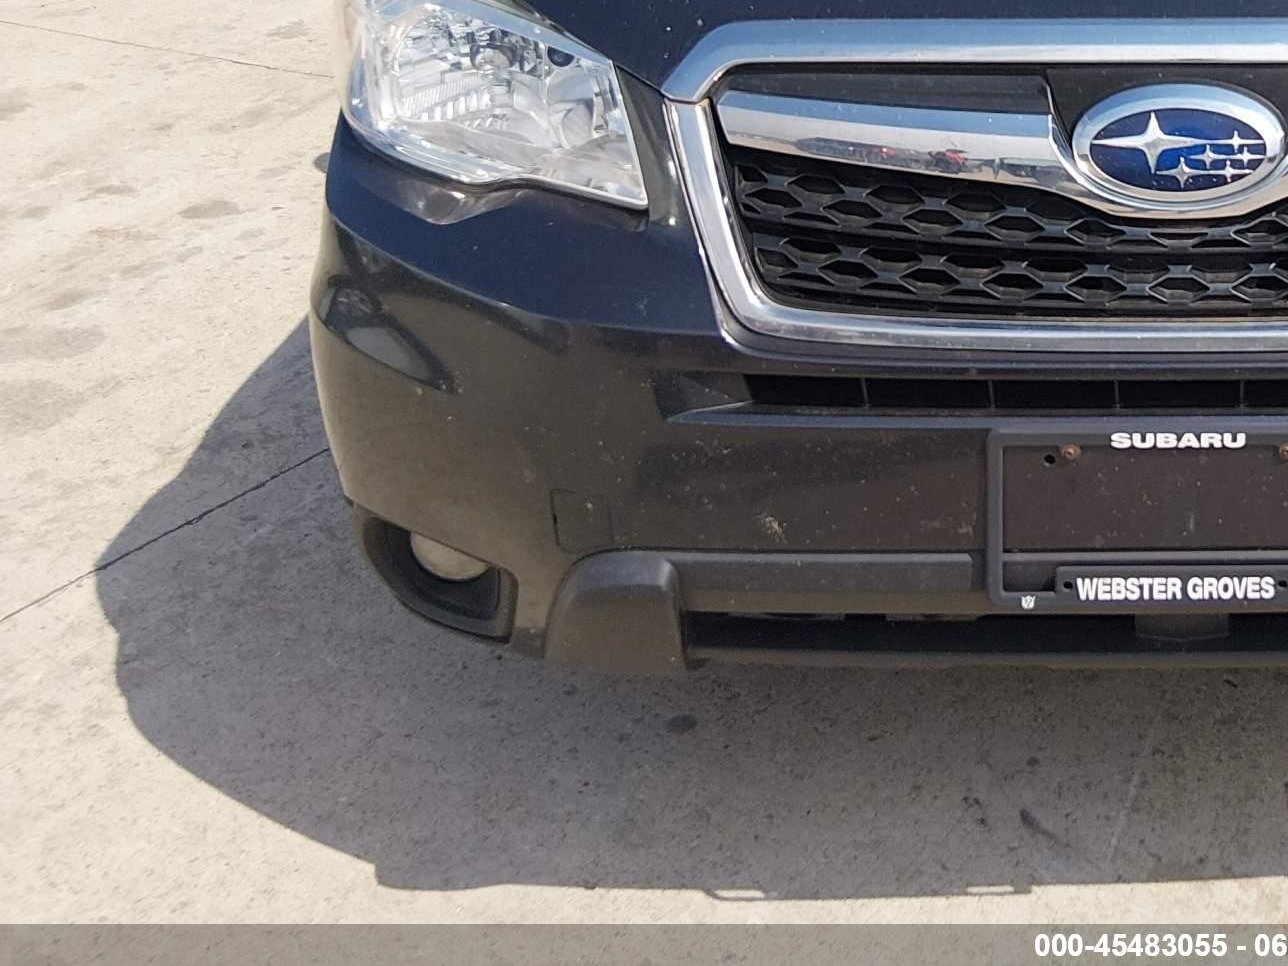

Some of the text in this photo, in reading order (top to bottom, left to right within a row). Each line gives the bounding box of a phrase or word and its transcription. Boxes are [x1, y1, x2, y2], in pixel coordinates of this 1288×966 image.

[1110, 432, 1246, 449] SUBARU
[1076, 576, 1275, 601] WEBSTER GROVES
